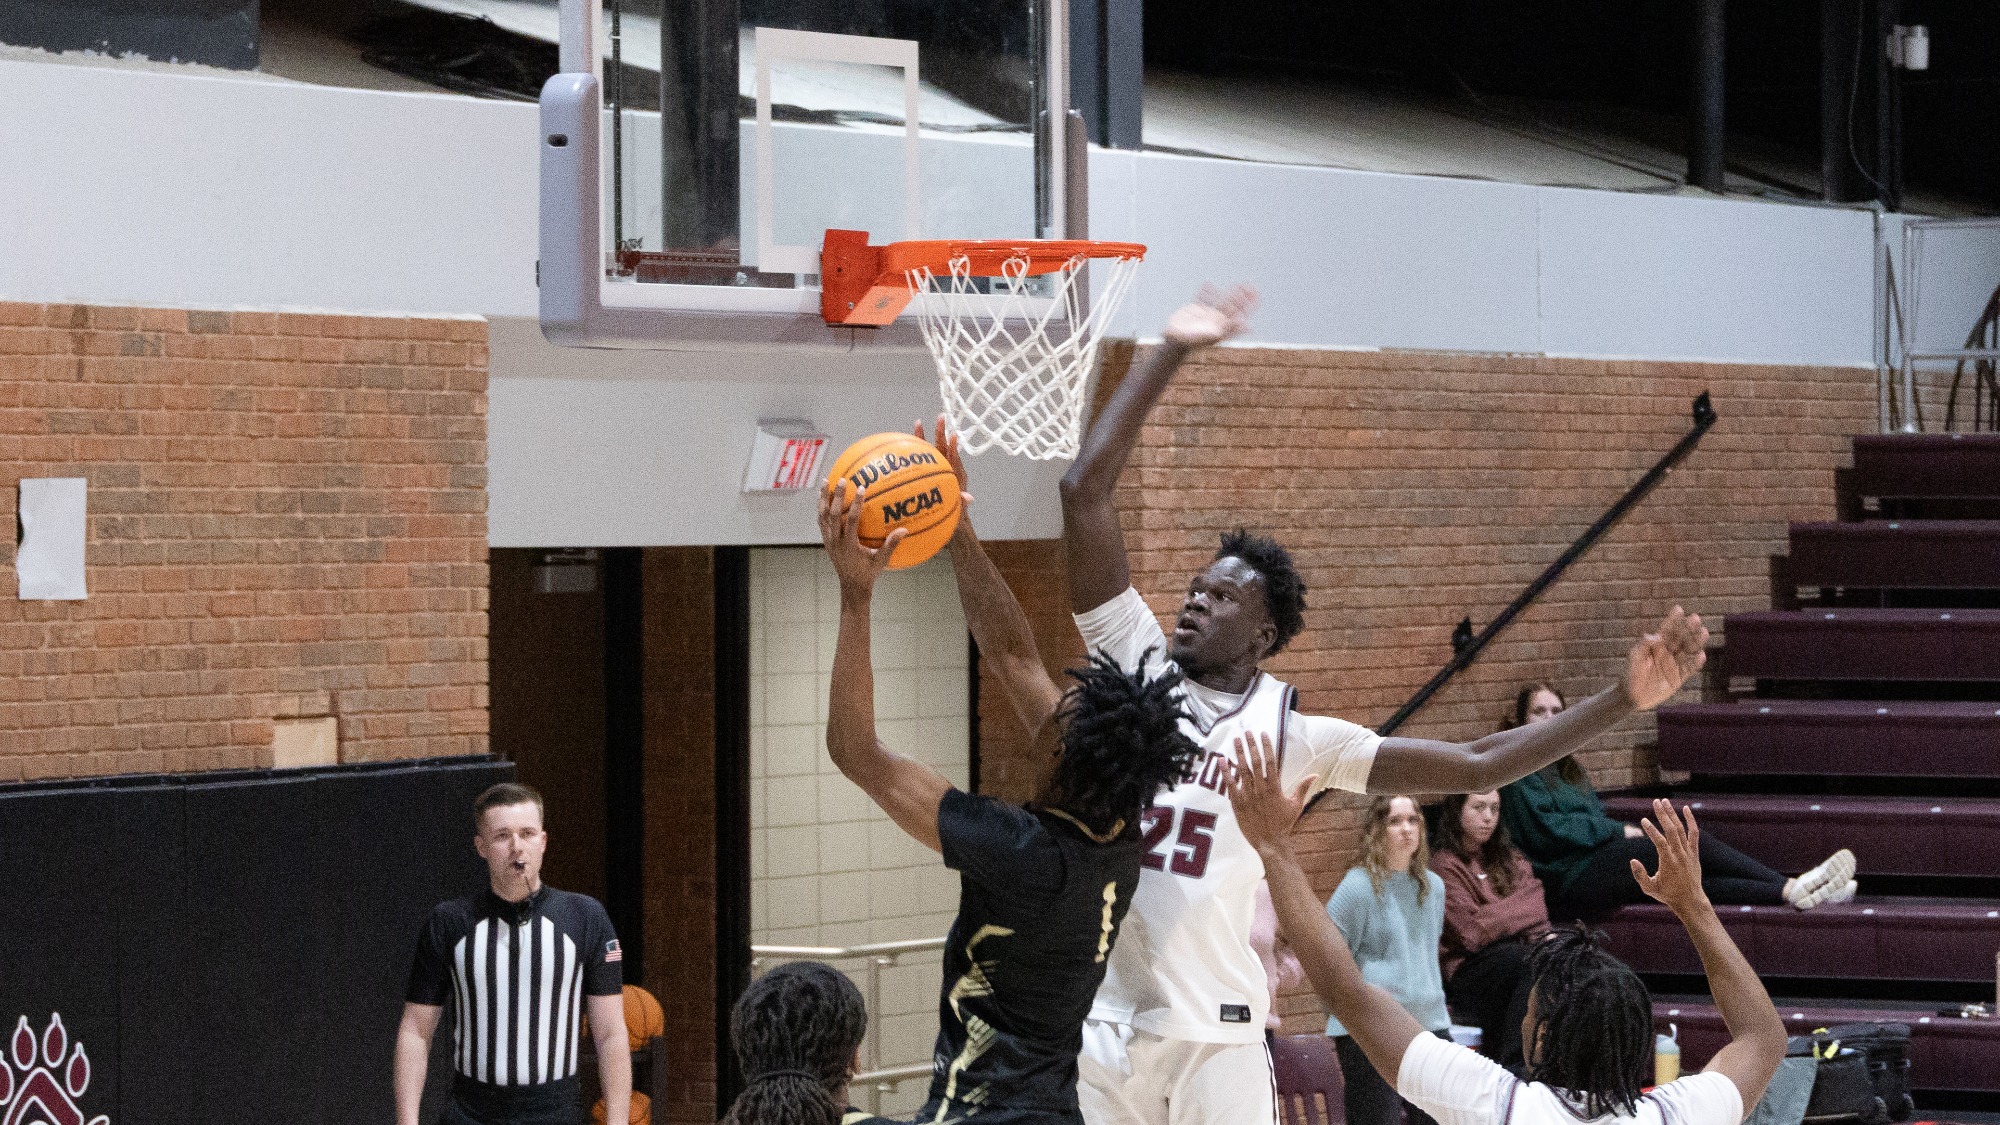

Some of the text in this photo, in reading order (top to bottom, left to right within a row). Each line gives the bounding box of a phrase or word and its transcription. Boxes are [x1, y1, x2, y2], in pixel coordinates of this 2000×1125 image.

[772, 439, 824, 489] EXIT
[849, 452, 938, 489] Wilson
[881, 486, 943, 524] NCAA
[1139, 804, 1219, 879] 25
[1094, 880, 1117, 964] 1
